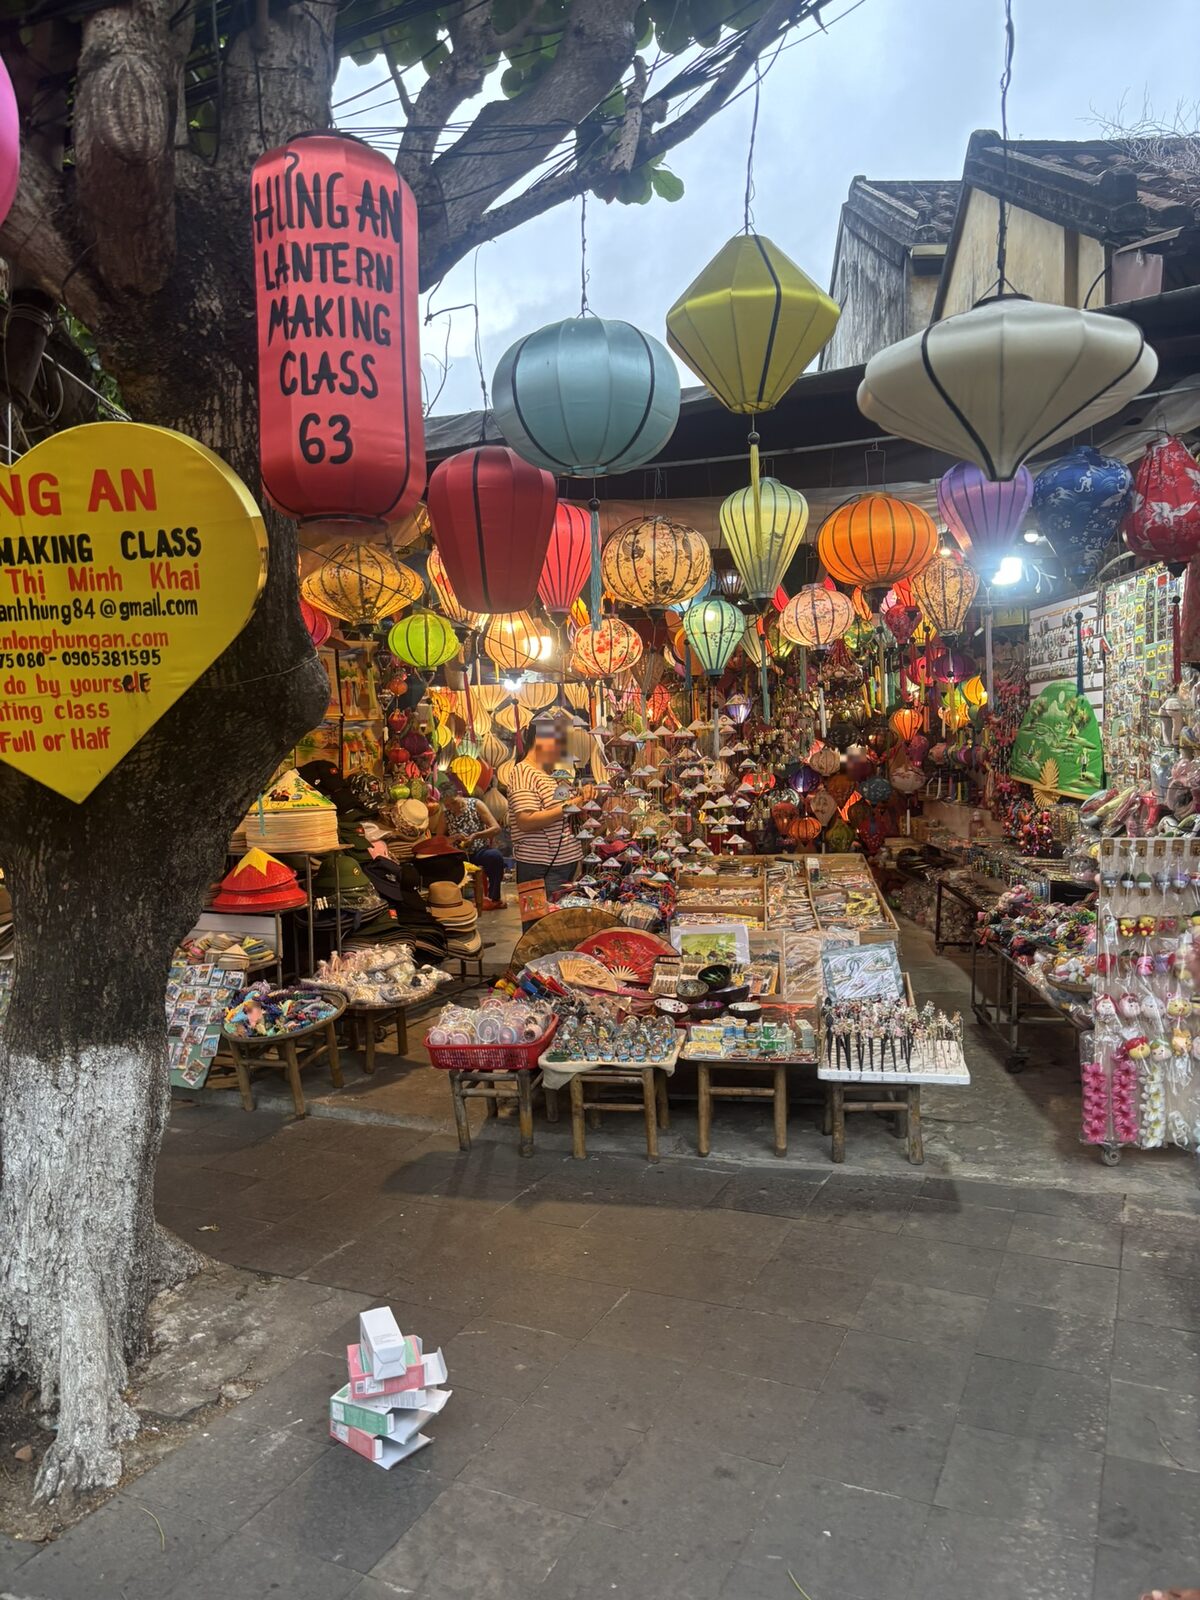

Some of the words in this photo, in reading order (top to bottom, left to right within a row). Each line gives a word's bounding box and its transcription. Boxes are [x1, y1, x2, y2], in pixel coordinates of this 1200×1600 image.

[355, 179, 402, 243] AN
[263, 241, 394, 294] LANTERN
[267, 294, 392, 347] MAKING
[279, 350, 379, 399] CLASS
[299, 412, 354, 465] 63
[87, 467, 158, 513] AN
[120, 526, 202, 561] CLASS
[4, 568, 46, 601] Thị
[67, 565, 123, 592] Minh
[149, 561, 201, 591] Khai
[4, 674, 26, 695] do
[36, 673, 61, 699] by
[54, 699, 110, 720] class
[0, 729, 36, 753] Full
[42, 733, 66, 752] or
[70, 726, 111, 750] Half
